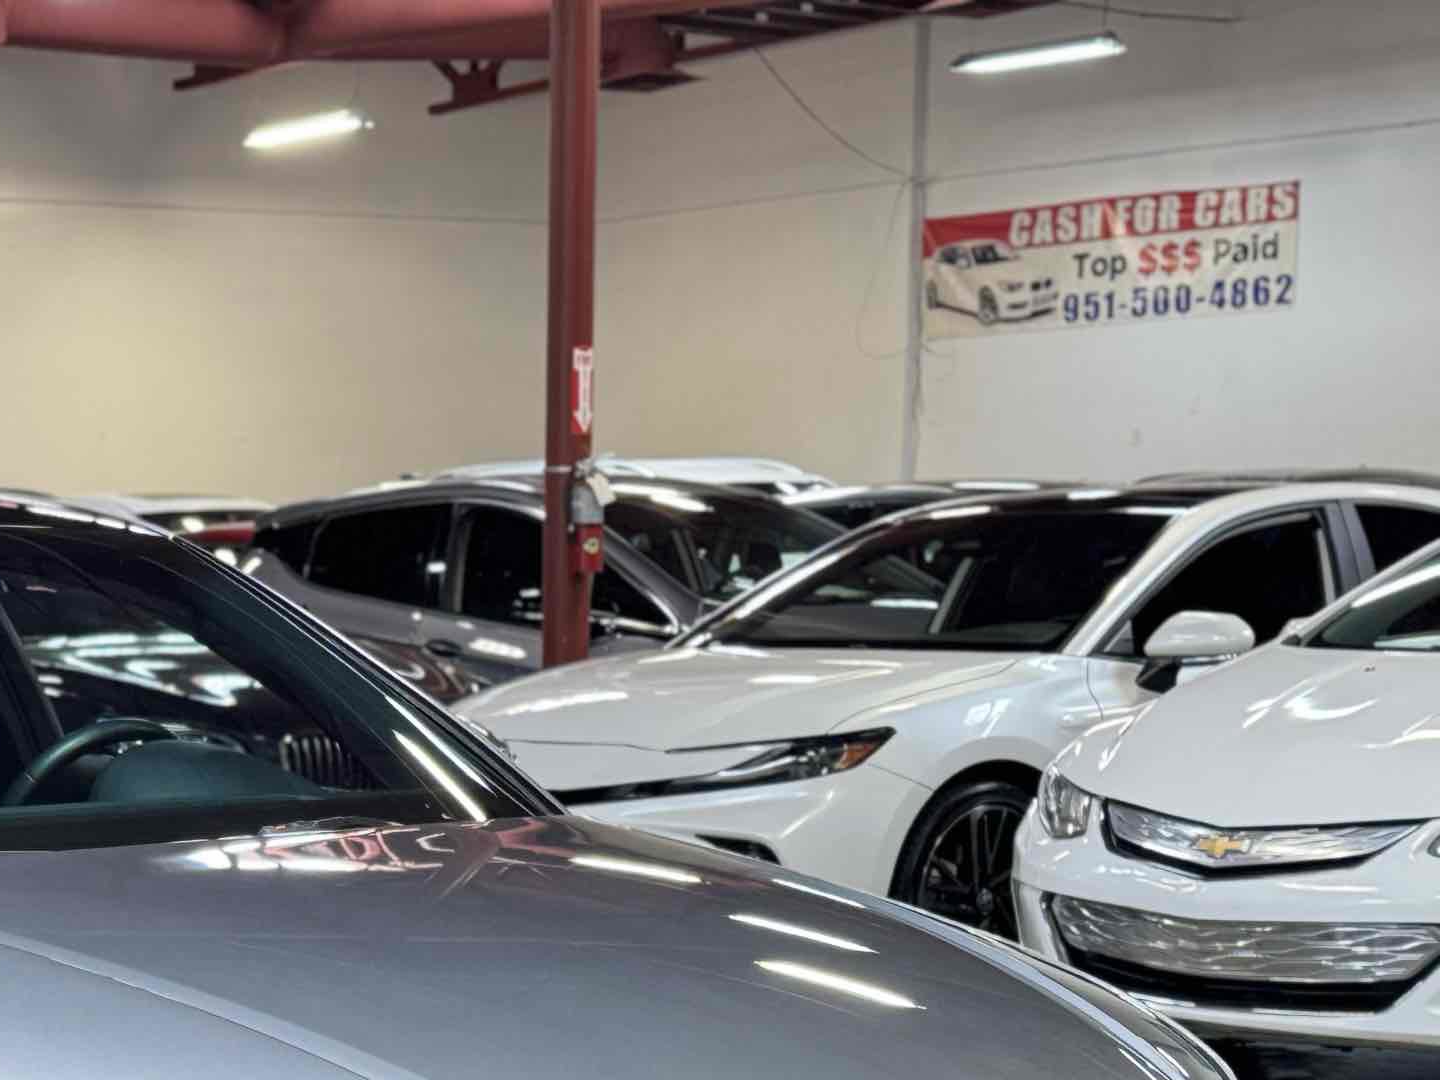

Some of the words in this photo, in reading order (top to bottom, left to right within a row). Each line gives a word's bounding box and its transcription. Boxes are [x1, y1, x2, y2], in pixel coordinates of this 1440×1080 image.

[1009, 202, 1106, 247] CASH
[1115, 192, 1181, 237] FOR
[1194, 182, 1296, 228] CARS
[1073, 251, 1128, 281] Top
[1137, 237, 1203, 278] $$$
[1212, 232, 1280, 265] Paid
